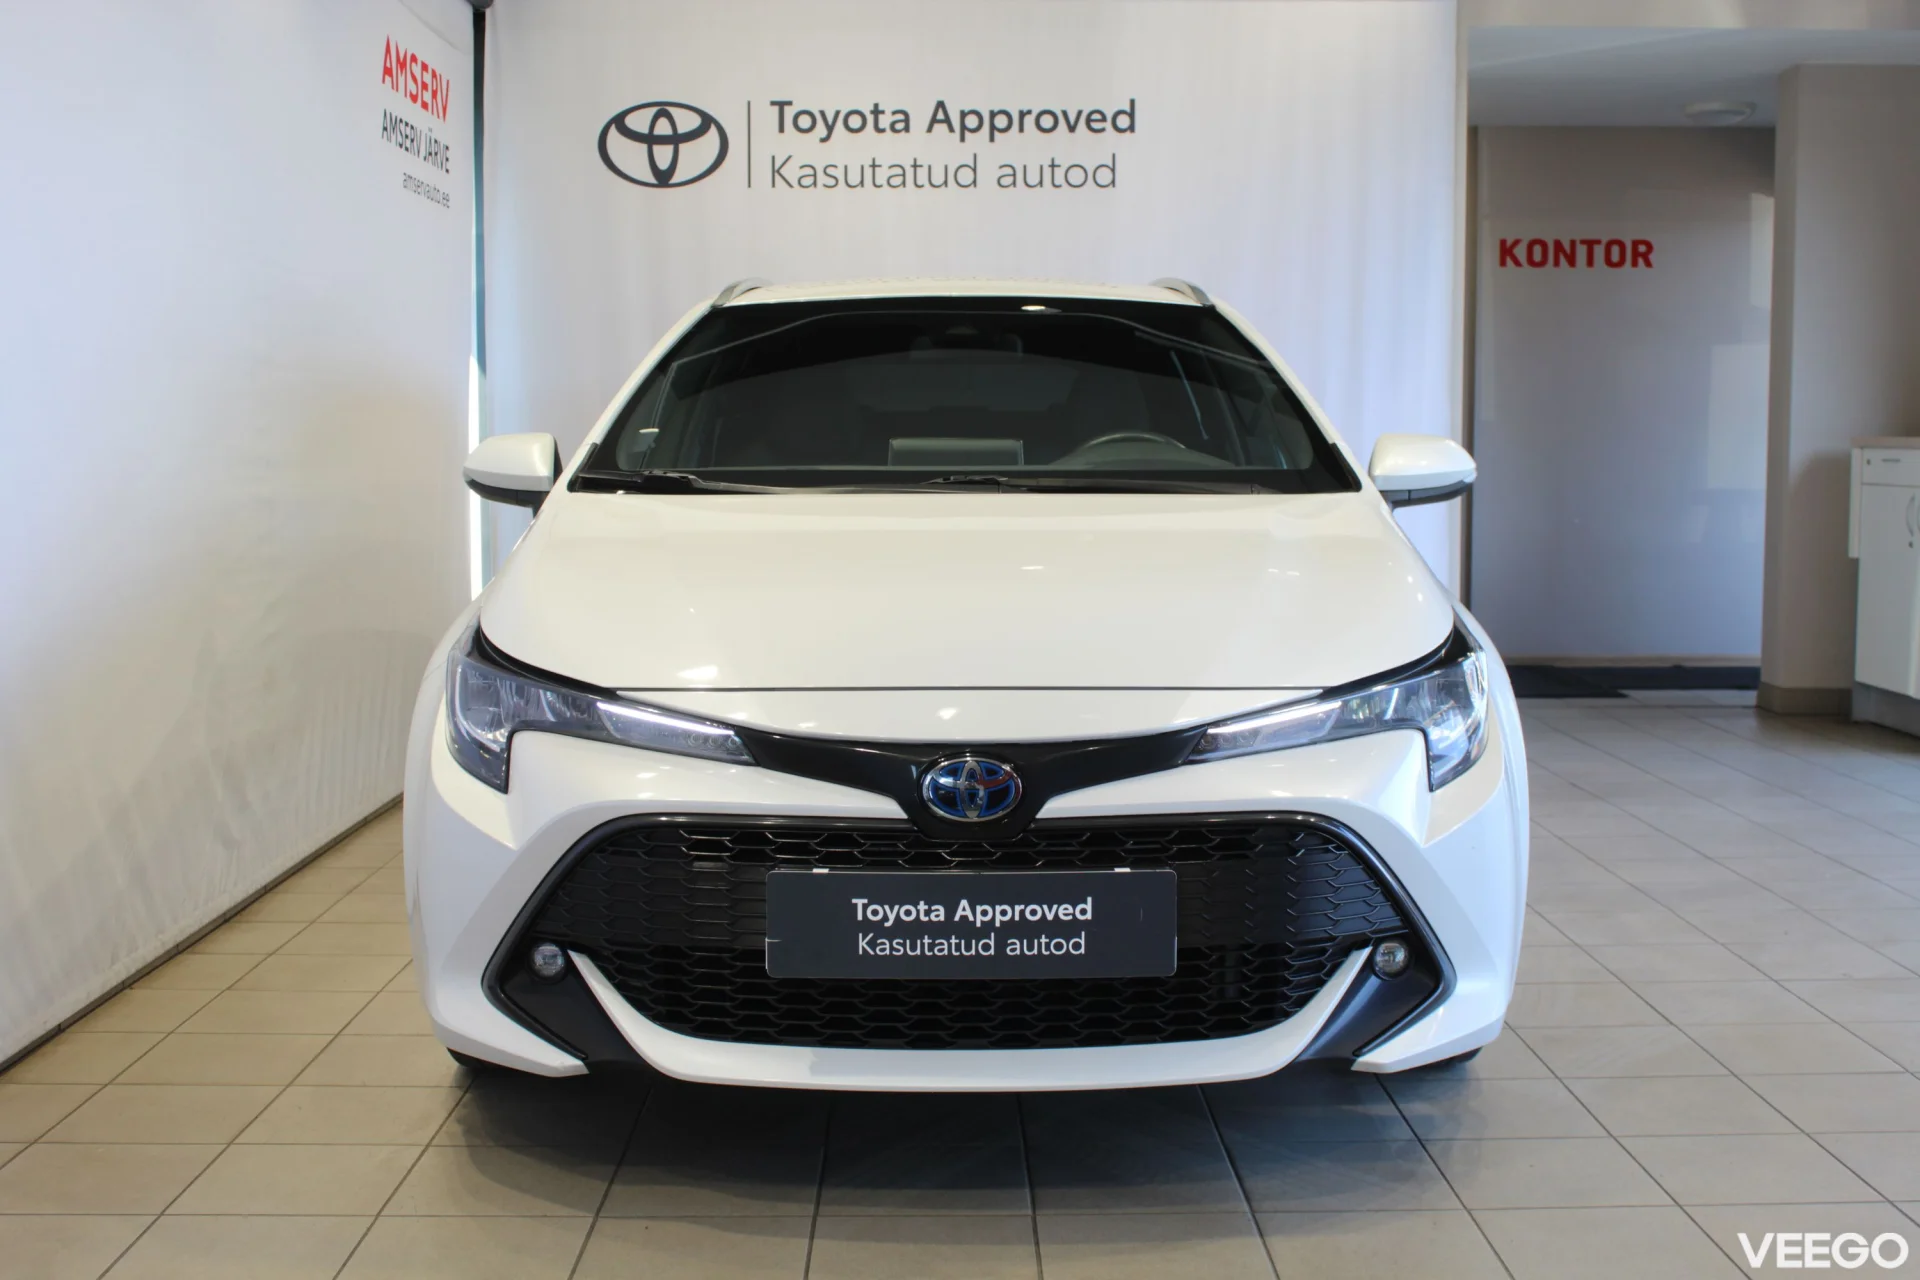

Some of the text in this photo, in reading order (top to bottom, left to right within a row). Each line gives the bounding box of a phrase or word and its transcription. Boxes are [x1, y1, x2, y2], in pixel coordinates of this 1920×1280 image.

[382, 34, 450, 124] AMSERV
[769, 98, 1136, 143] Toyota Approved
[382, 108, 450, 174] AMSERV JÄRVE
[770, 153, 1117, 189] Kasutatud autod
[402, 172, 450, 208] amservauto.ee
[1498, 238, 1654, 269] KONTOR
[852, 896, 1093, 927] Toyota Approved
[857, 931, 1087, 956] Kasutatud autod
